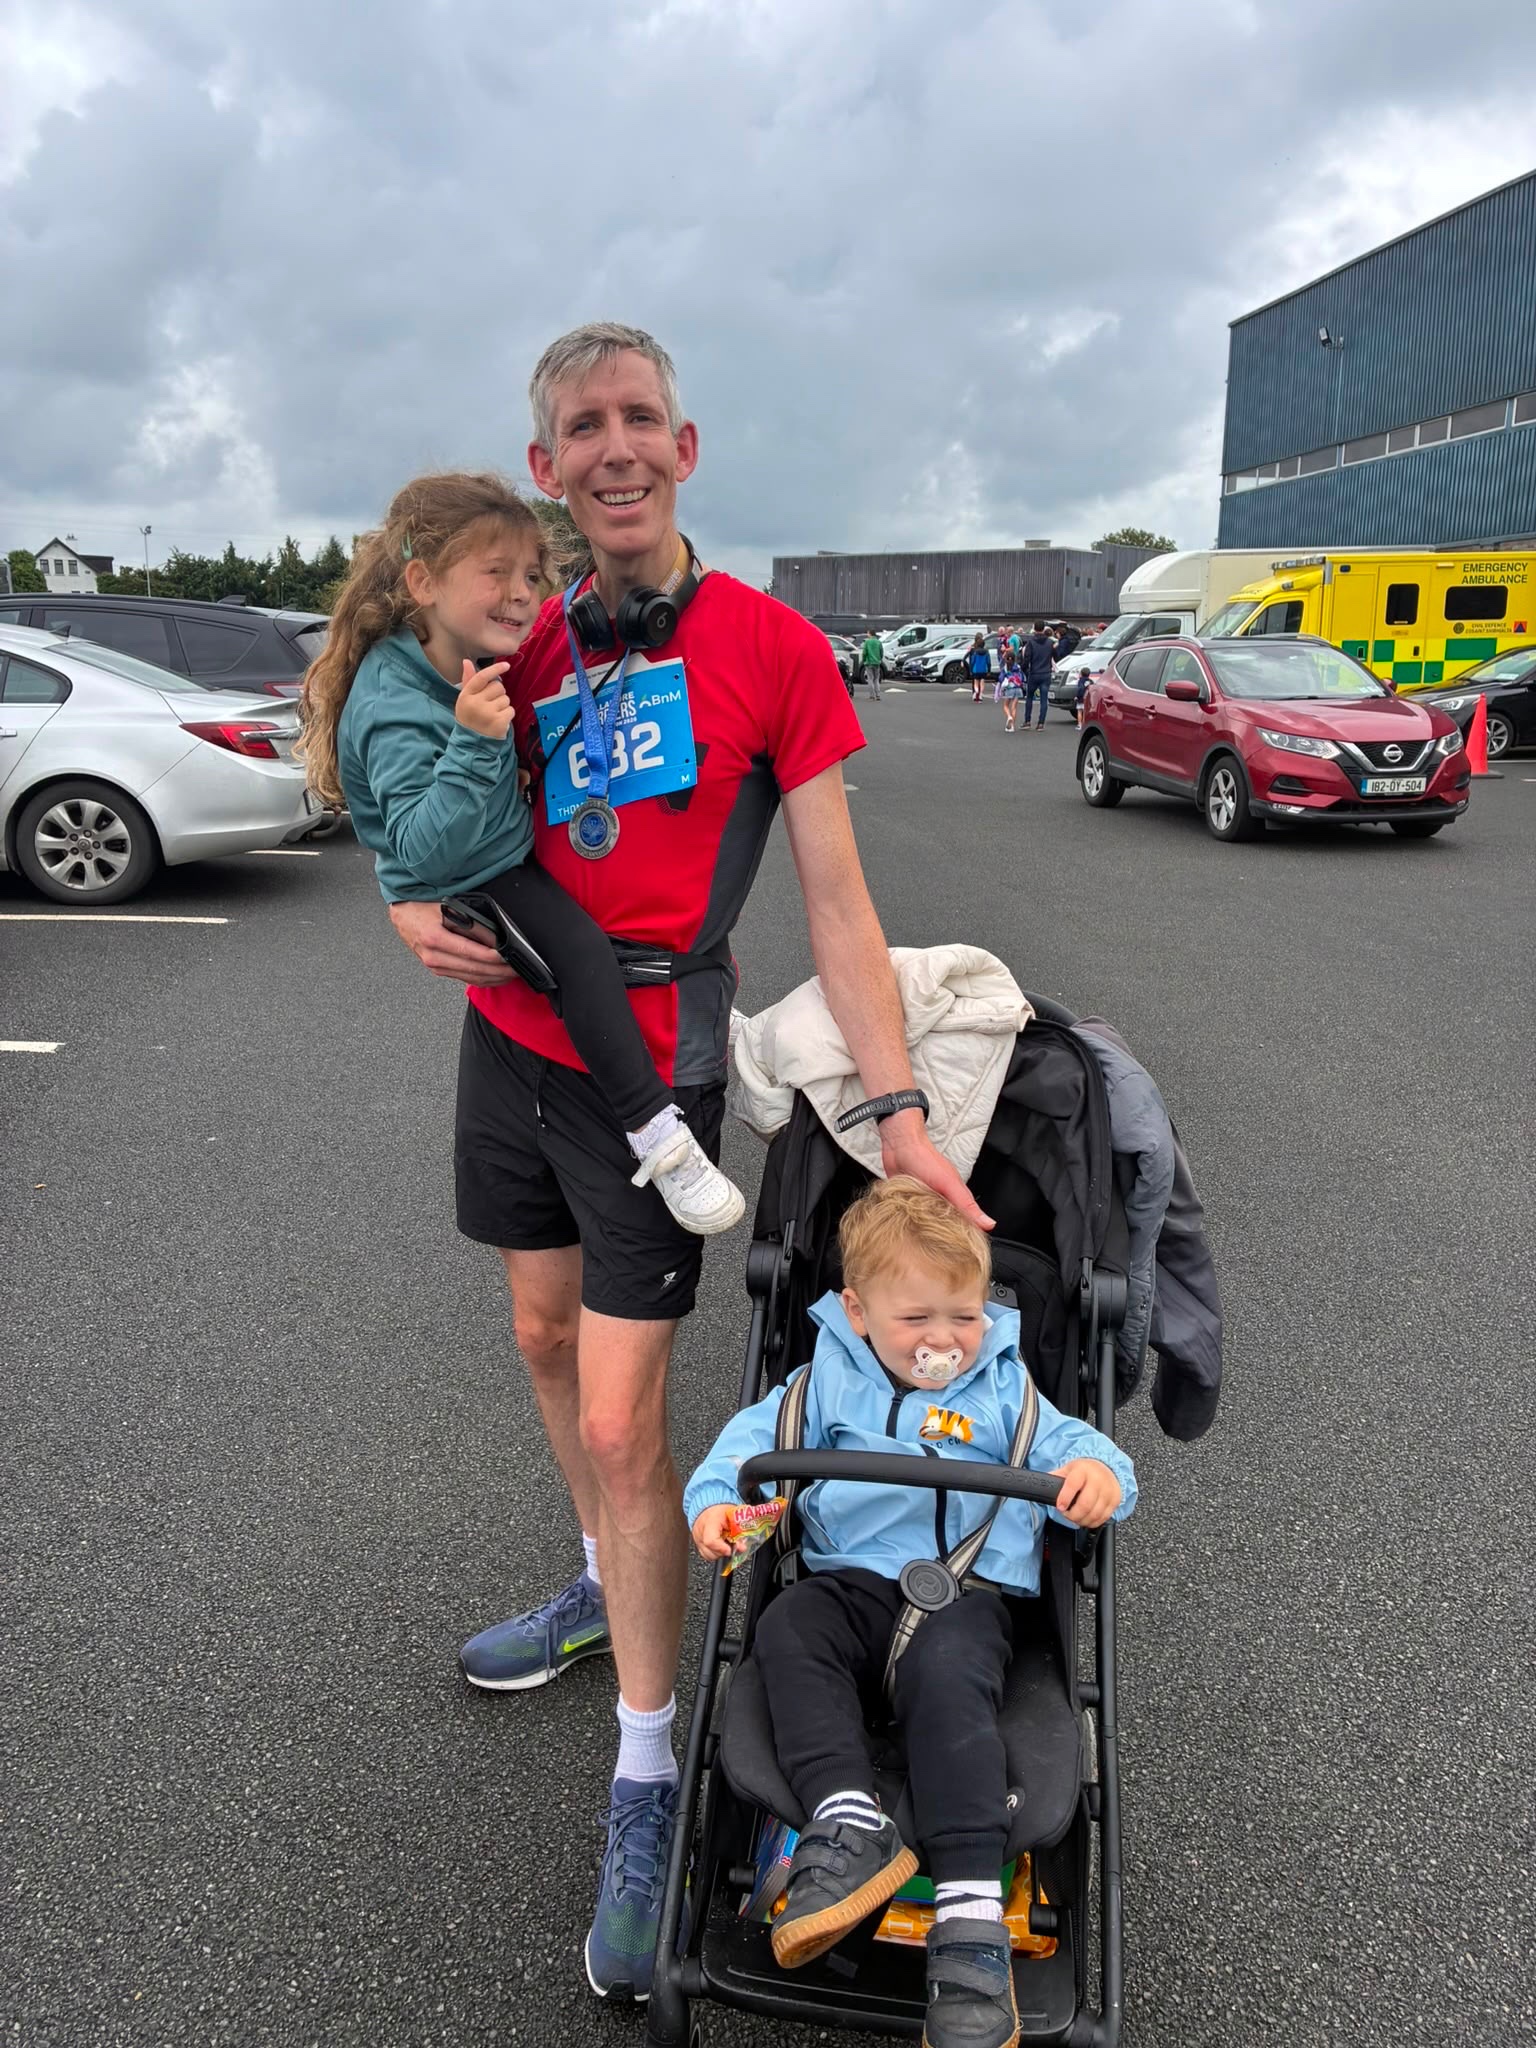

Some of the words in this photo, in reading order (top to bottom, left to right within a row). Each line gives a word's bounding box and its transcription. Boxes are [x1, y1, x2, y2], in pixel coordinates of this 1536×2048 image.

[1463, 563, 1528, 573] EMERGENCY
[1461, 574, 1528, 585] AMBULANCE
[651, 690, 681, 706] BnM
[556, 717, 581, 737] BM
[681, 774, 691, 785] M
[1371, 780, 1422, 792] 182-OY-504
